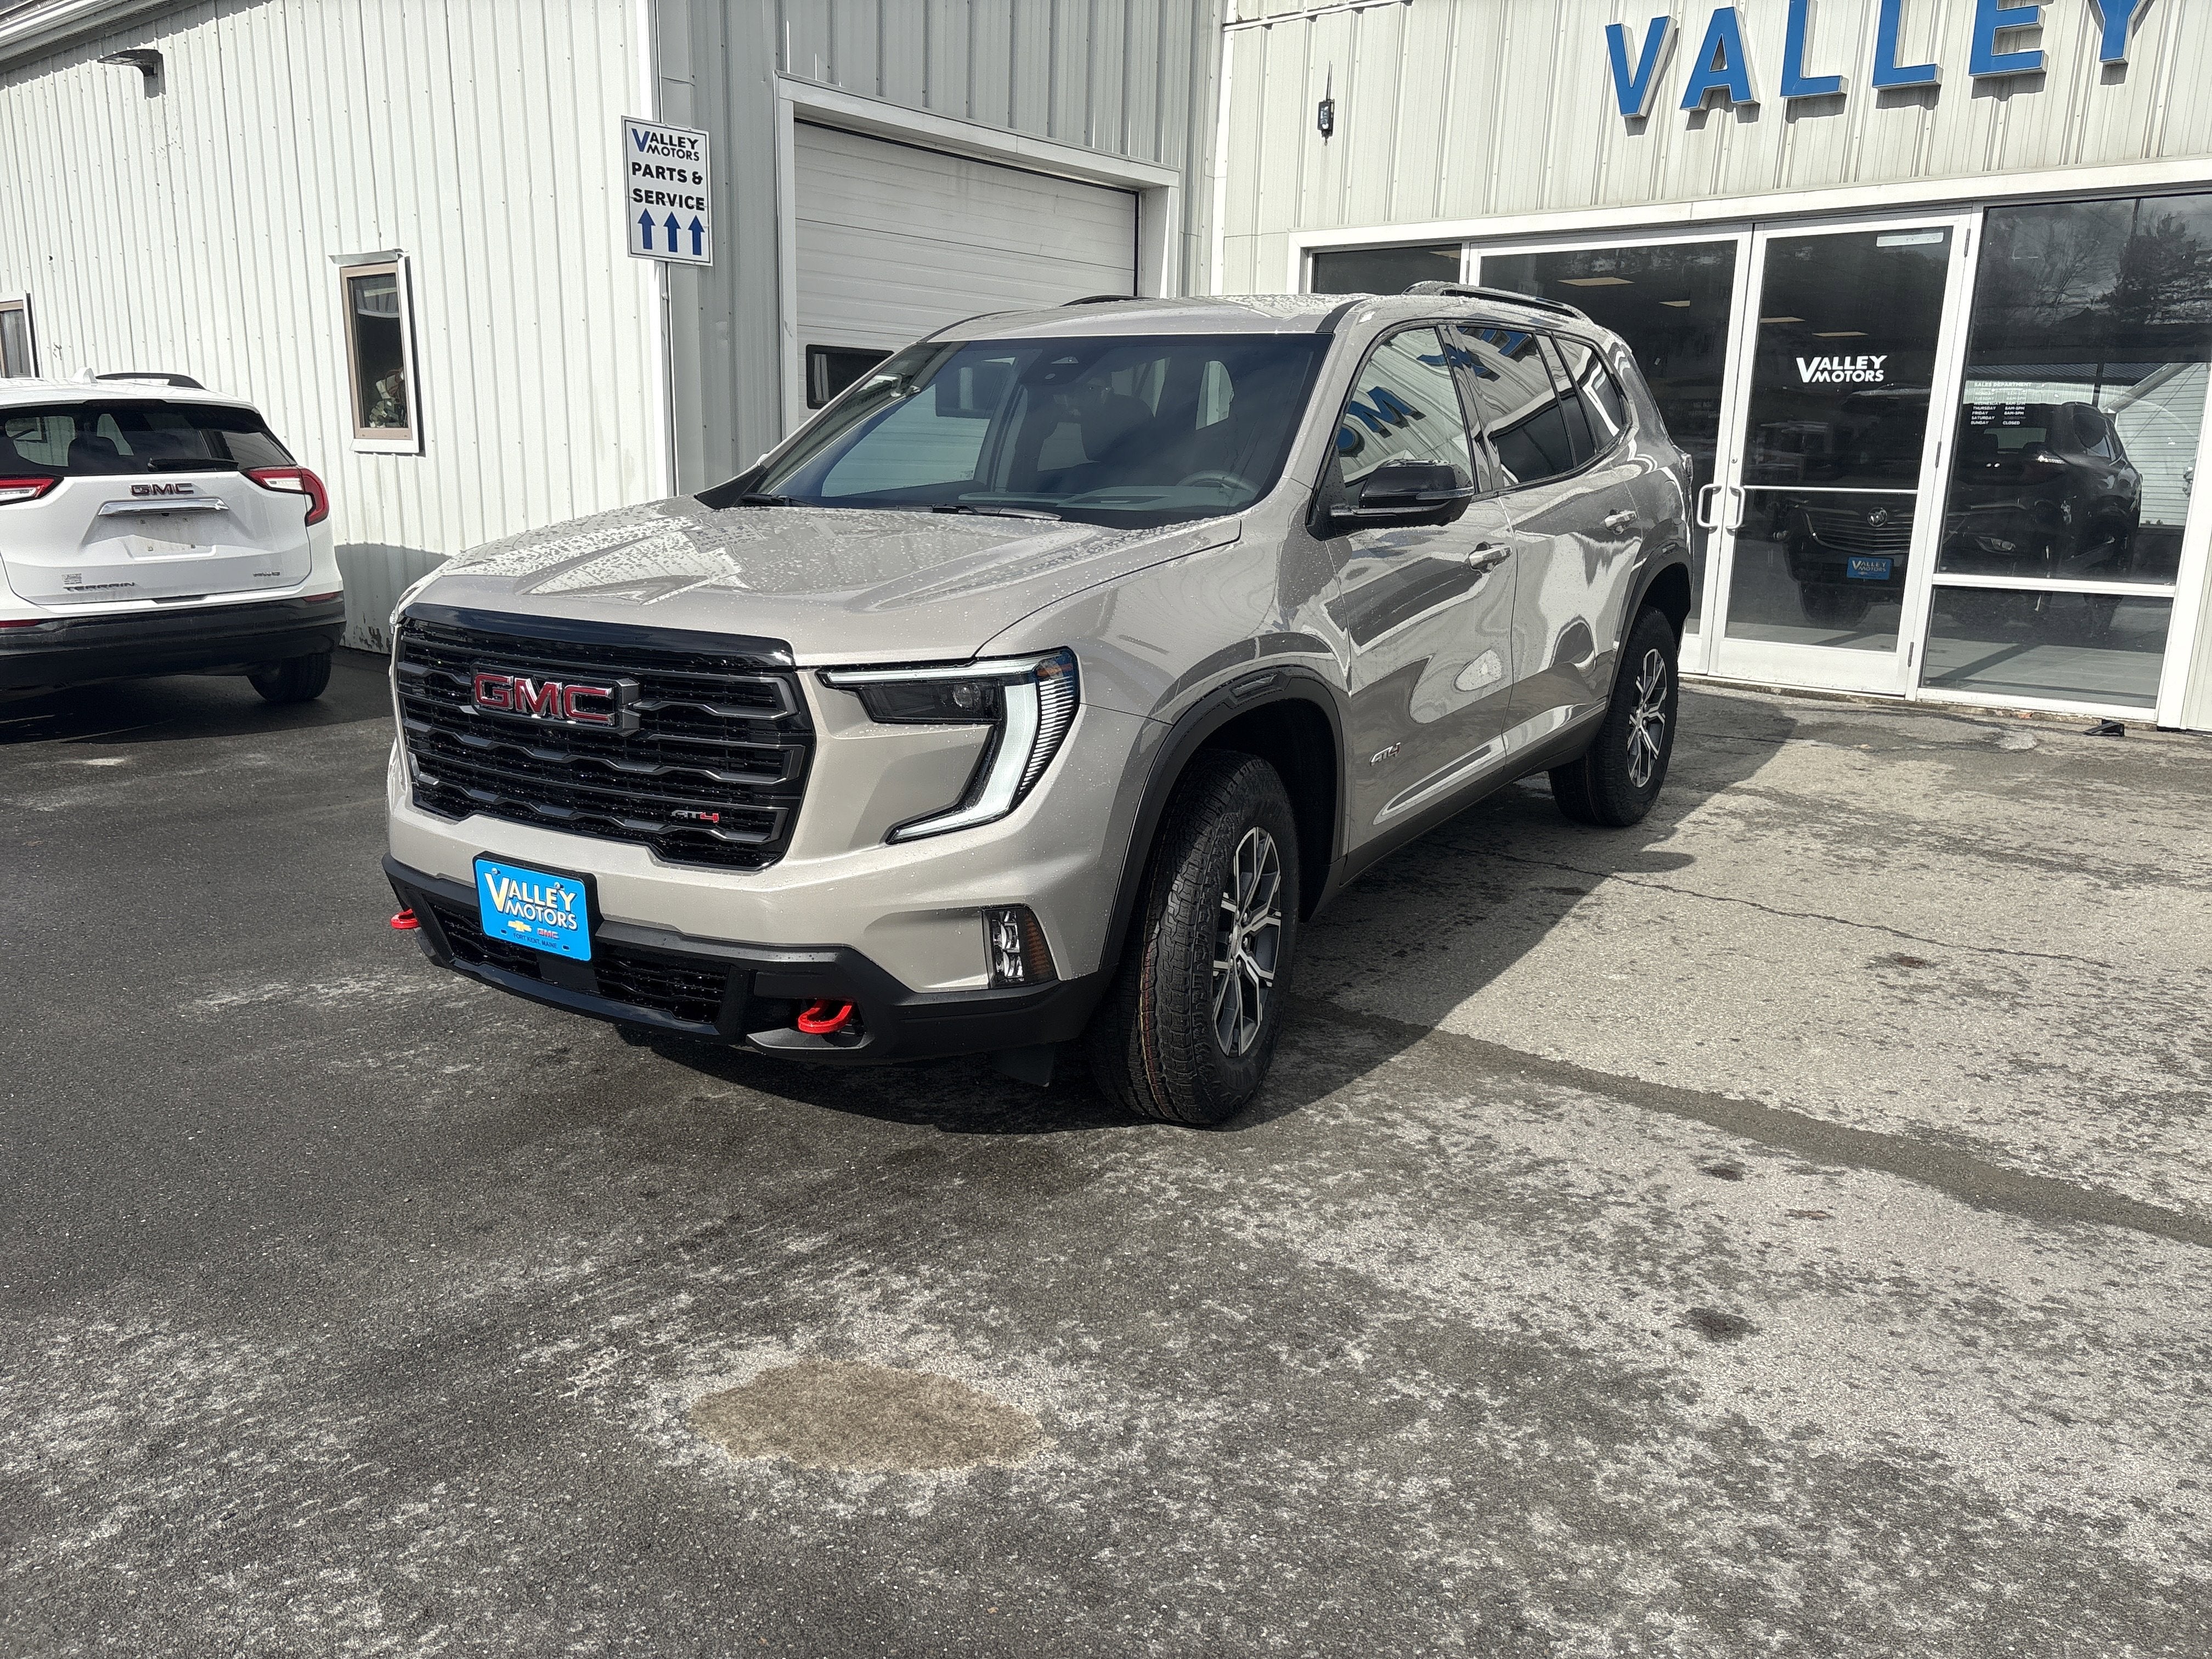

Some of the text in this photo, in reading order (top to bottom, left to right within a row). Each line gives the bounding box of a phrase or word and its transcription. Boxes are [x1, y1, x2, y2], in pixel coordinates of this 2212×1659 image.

[631, 128, 699, 153] VALLEY
[646, 144, 700, 161] MOTORS
[631, 161, 703, 185] PARTS &
[633, 188, 706, 211] SERVICE
[1796, 355, 1888, 383] VALLEY
[1812, 370, 1884, 382] MOTORS
[129, 483, 194, 496] GMC
[63, 582, 135, 591] TERRAIN
[474, 672, 614, 725] GMC
[1369, 742, 1401, 767] AT4
[670, 809, 720, 823] AT4
[483, 872, 578, 912] VALLEY
[505, 900, 578, 931] MOTORS
[537, 927, 560, 940] GMC
[541, 939, 558, 949] MAINE
